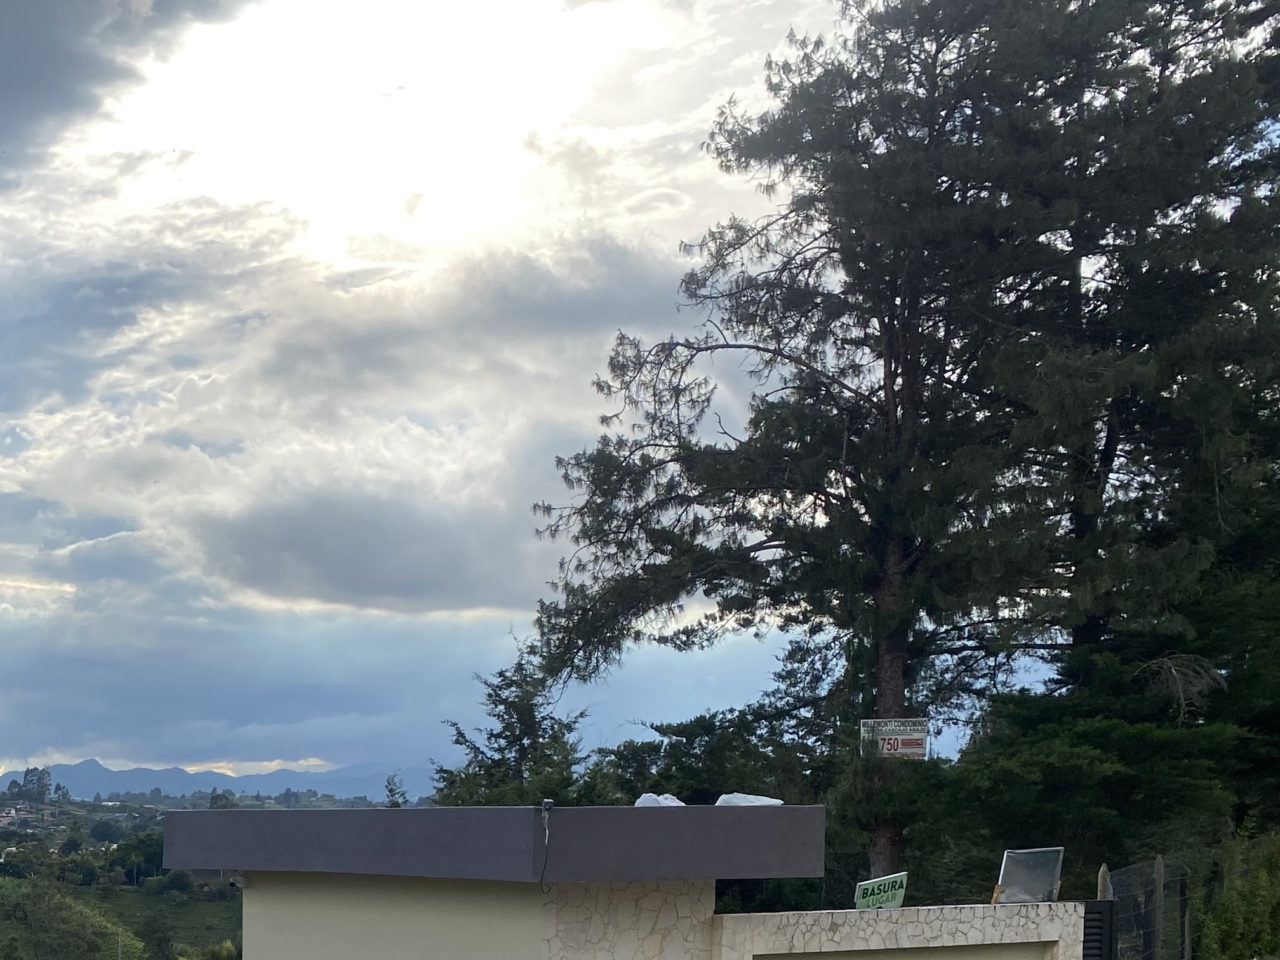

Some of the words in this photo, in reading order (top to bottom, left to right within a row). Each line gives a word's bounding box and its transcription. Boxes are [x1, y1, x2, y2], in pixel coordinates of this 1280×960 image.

[894, 719, 927, 728] CONDOMINIO
[880, 737, 899, 752] 750
[866, 892, 898, 908] LUGAR
